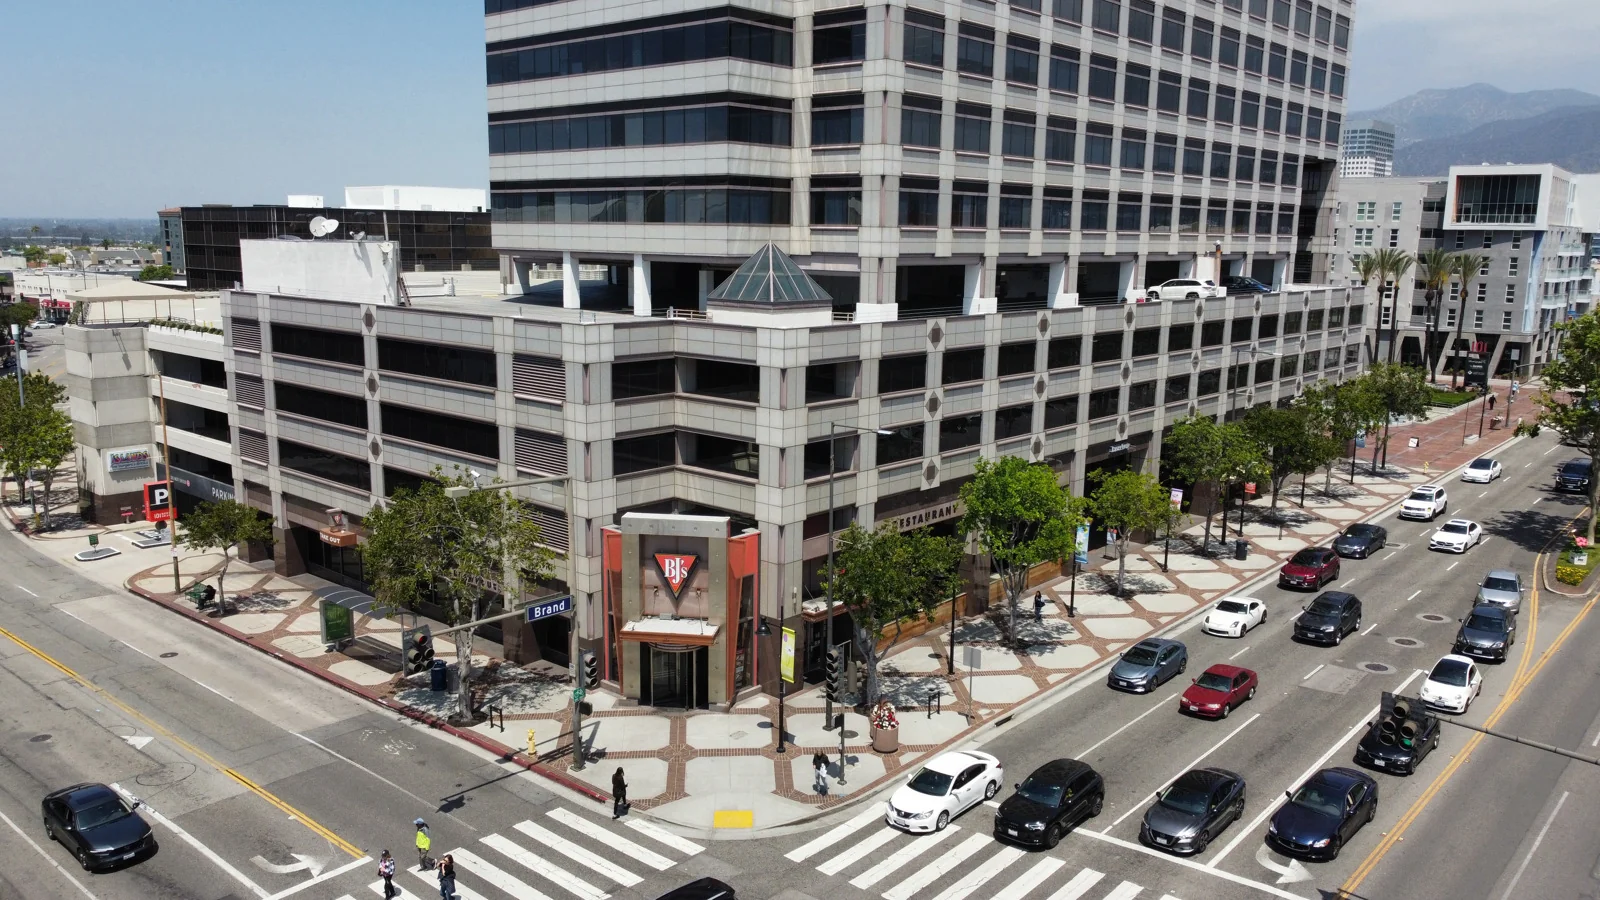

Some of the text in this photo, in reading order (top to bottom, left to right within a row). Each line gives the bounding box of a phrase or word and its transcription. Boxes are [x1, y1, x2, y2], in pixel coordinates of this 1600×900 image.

[1471, 341, 1487, 352] 101
[154, 488, 169, 505] P
[211, 487, 236, 501] PARKIN
[329, 536, 340, 544] OUT
[664, 557, 688, 584] BJ's
[534, 600, 565, 618] Brand
